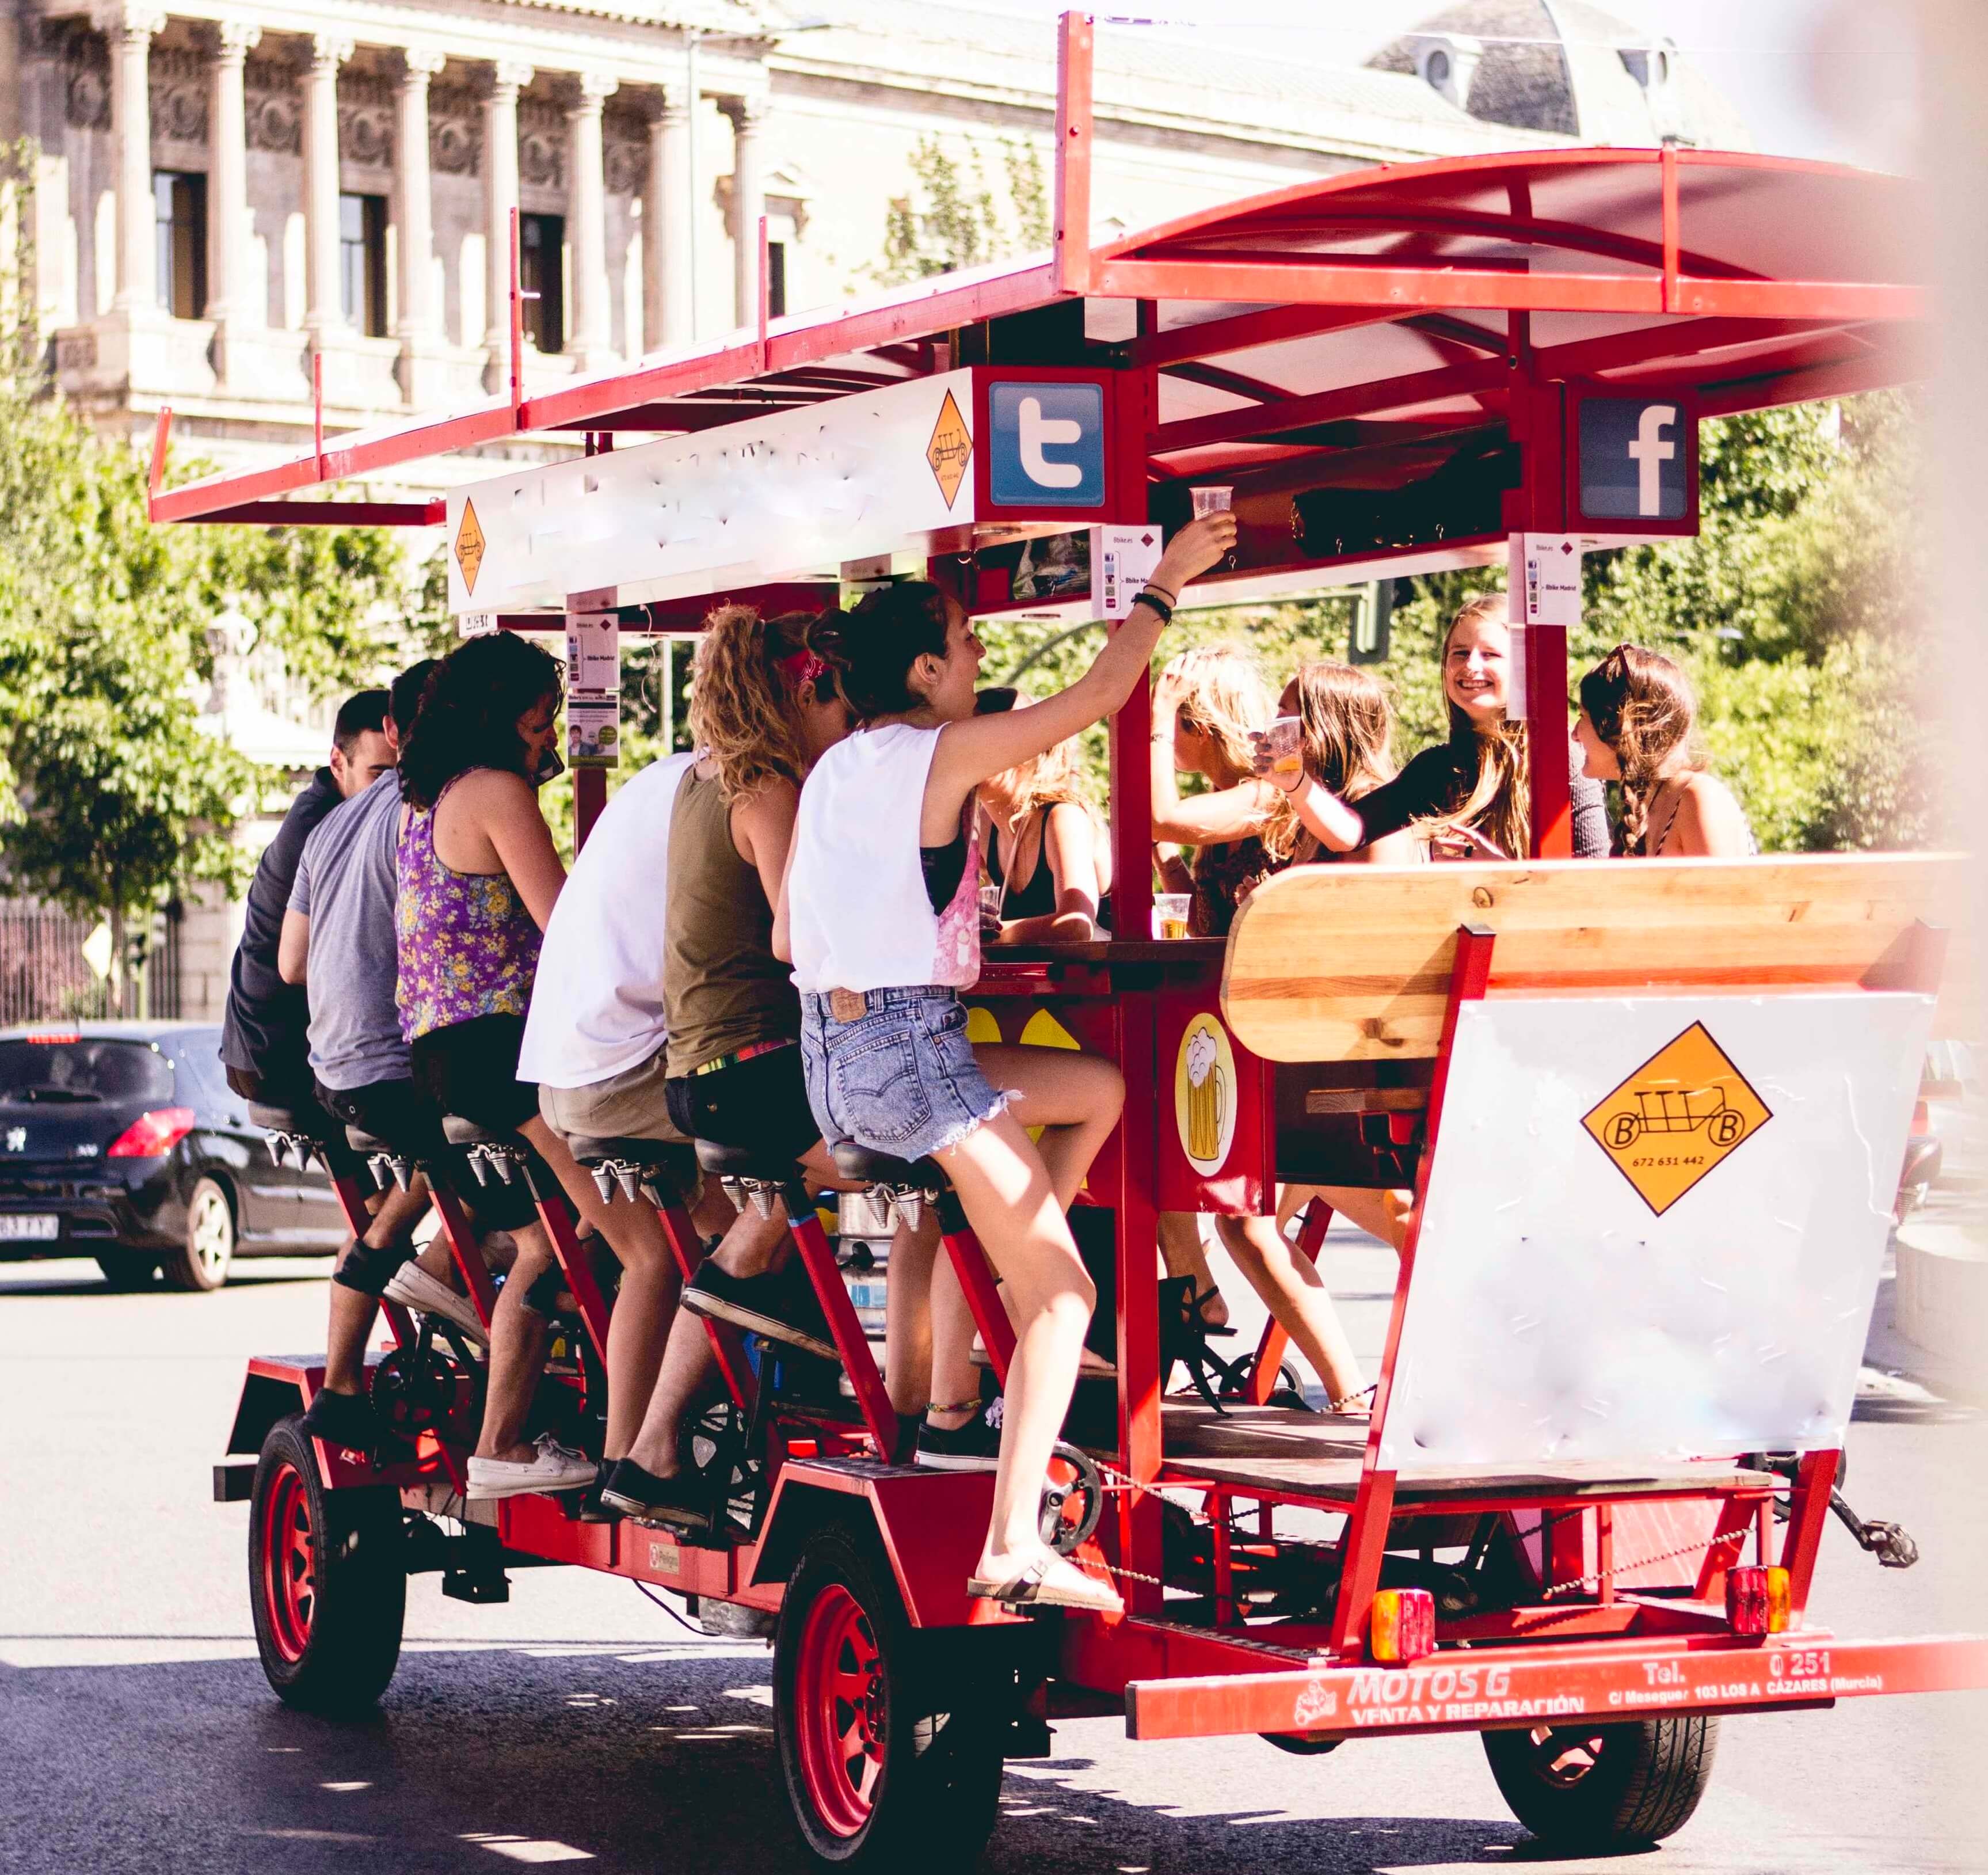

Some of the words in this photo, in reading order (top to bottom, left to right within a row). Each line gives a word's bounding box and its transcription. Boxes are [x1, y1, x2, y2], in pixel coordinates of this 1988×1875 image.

[1629, 405, 1676, 516] f
[1632, 1158, 1654, 1167] 672
[1658, 1157, 1678, 1166] 631
[1683, 1156, 1704, 1165] 442
[1643, 1660, 1686, 1685] Tel.
[1790, 1651, 1830, 1676] 251
[1347, 1668, 1479, 1705] MOTOS
[1694, 1685, 1718, 1699] 103
[1720, 1683, 1747, 1698] LOS
[1766, 1678, 1827, 1695] CÁZARES
[1830, 1675, 1883, 1693] (Murcia)
[1351, 1705, 1423, 1725] VENTA
[1426, 1705, 1442, 1721] Y
